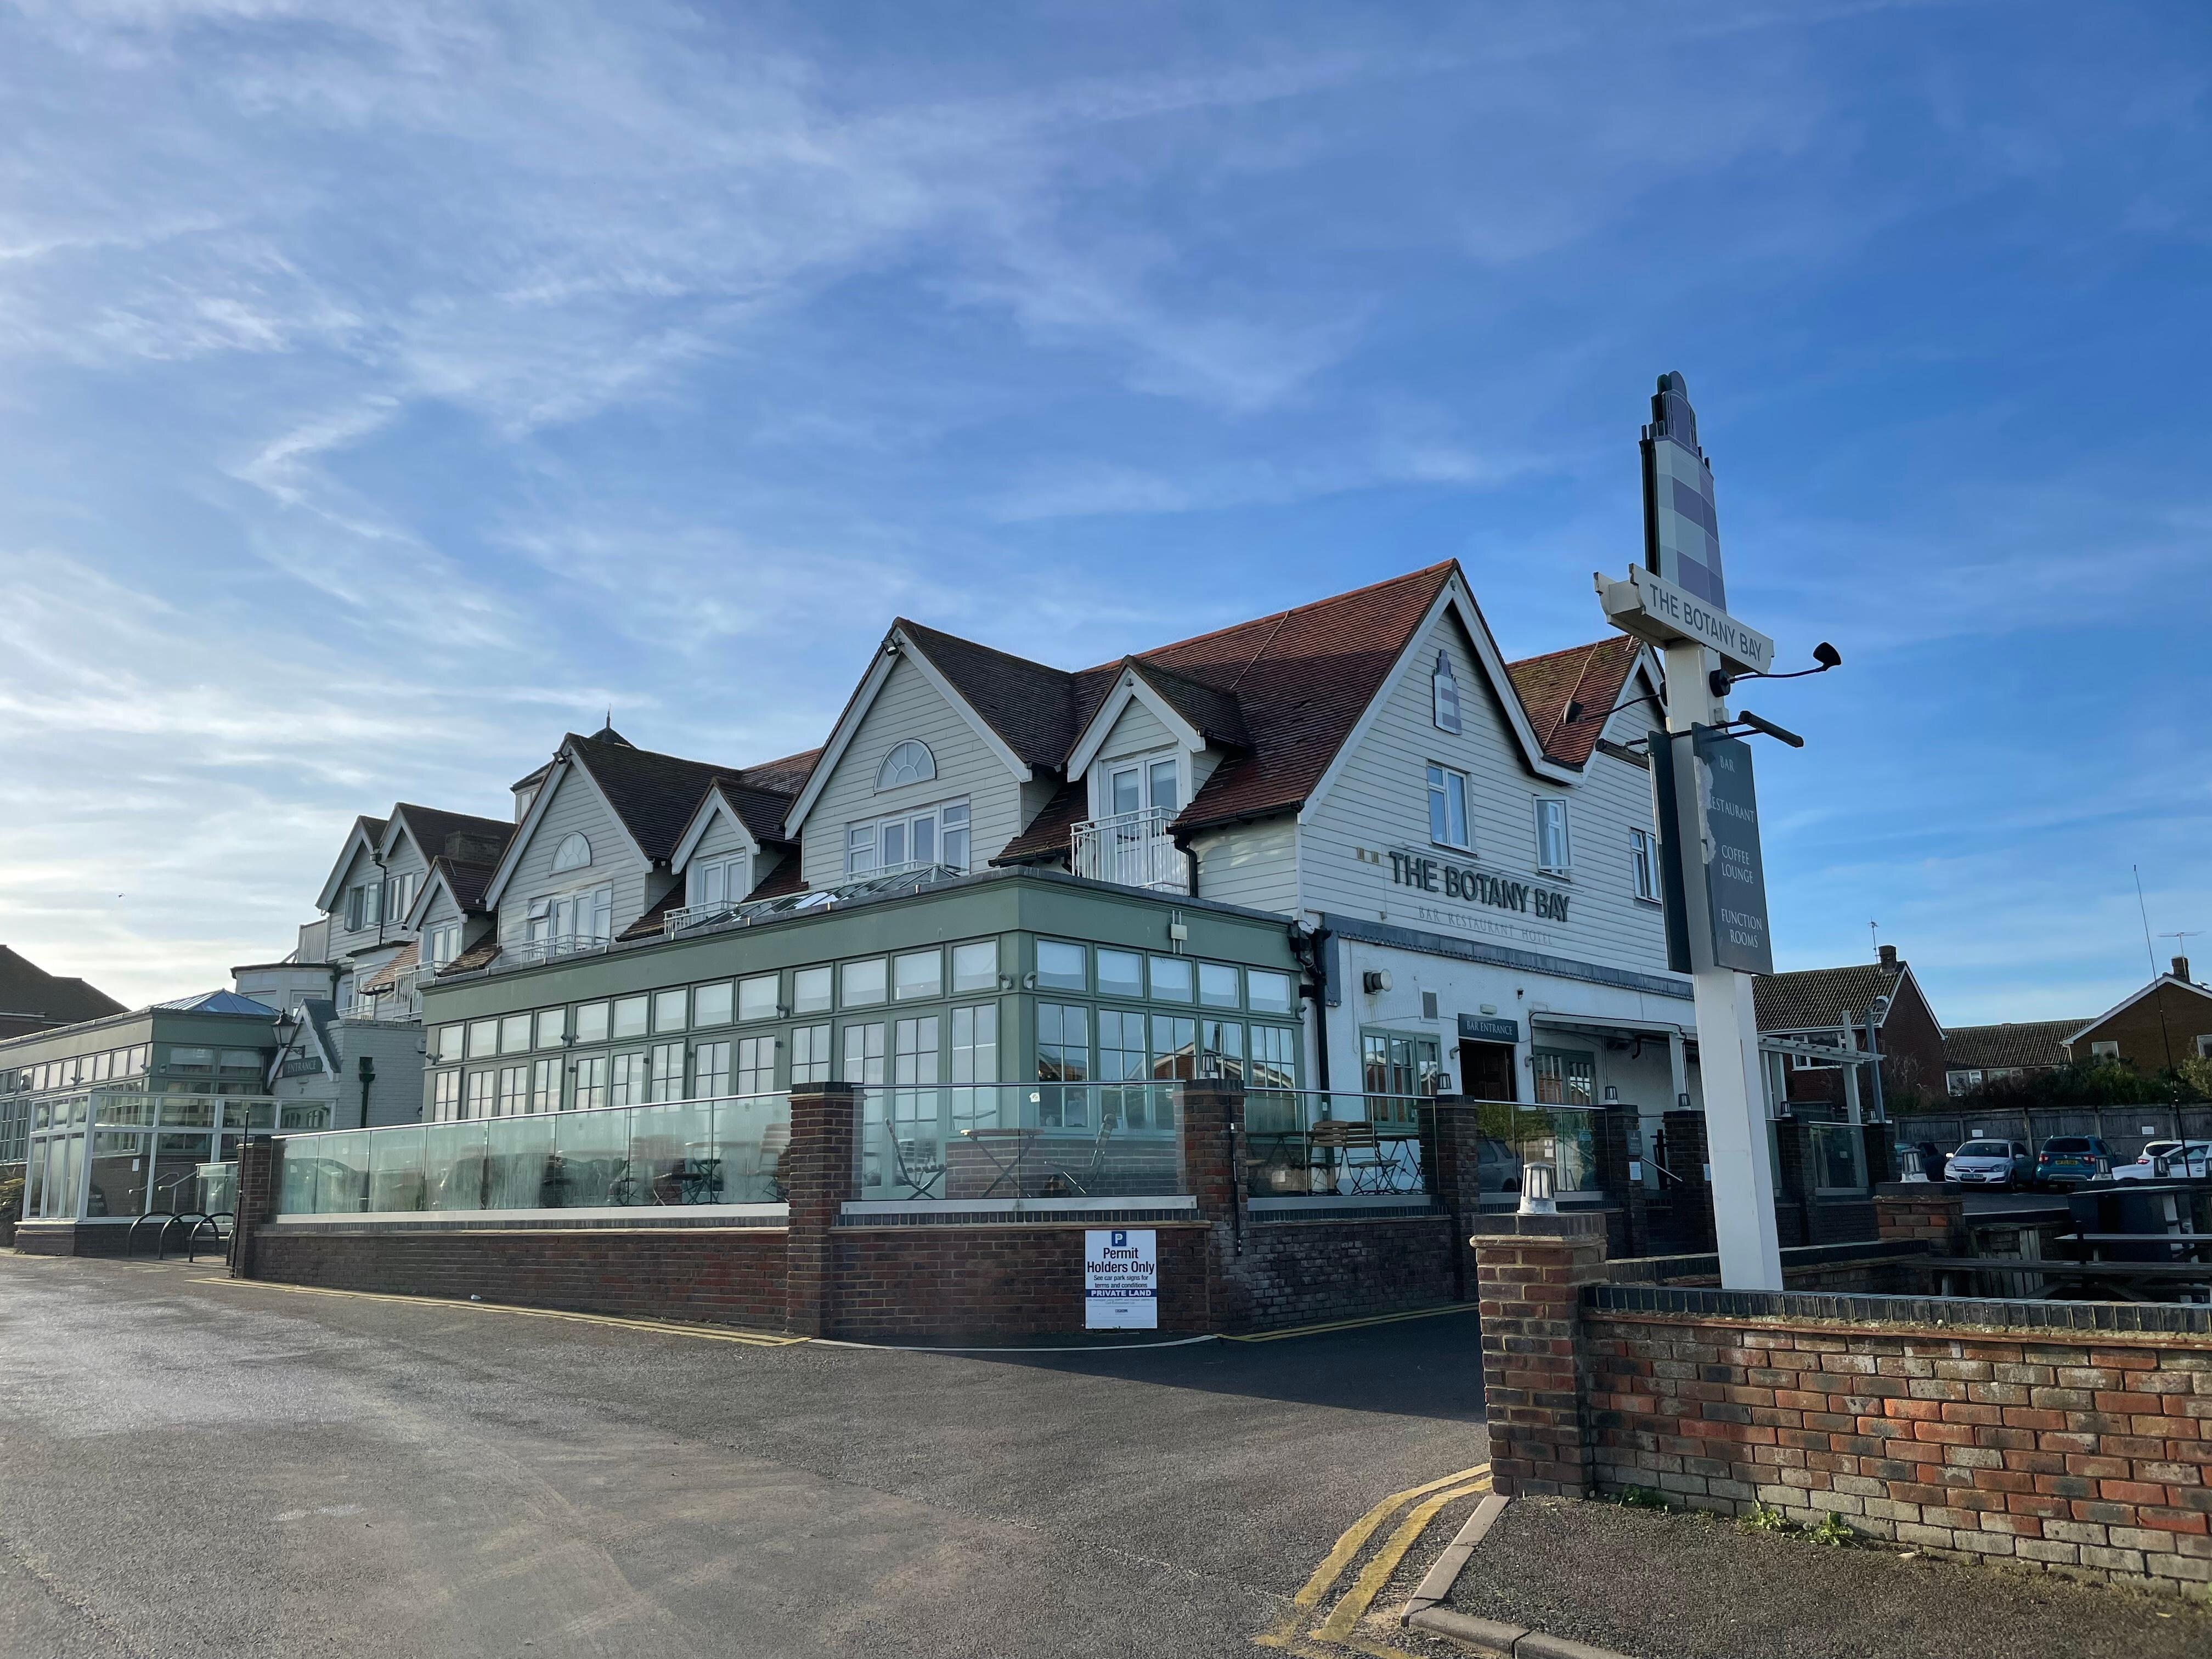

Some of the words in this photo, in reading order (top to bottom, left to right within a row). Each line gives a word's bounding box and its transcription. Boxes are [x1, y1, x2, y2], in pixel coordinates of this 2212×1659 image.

[1649, 583, 1679, 619] THE
[1684, 602, 1735, 648] BOTANY
[1740, 633, 1762, 662] BAY
[1719, 755, 1735, 773] BAR
[1711, 795, 1754, 823] ESTAURANT
[1722, 844, 1750, 866] COFFEE
[1722, 862, 1753, 884] LOUNGE
[1389, 850, 1439, 893] THE
[1446, 865, 1530, 913] BOTANY
[1535, 888, 1570, 922] BAY
[1419, 906, 1440, 923] BAR
[1448, 912, 1514, 937] RESTAURANT
[1522, 929, 1553, 945] HOTEL
[1721, 908, 1763, 932] FUNCTION
[1730, 929, 1759, 949] ROOMS
[1466, 1020, 1479, 1031] BAR
[1480, 1022, 1513, 1035] ENTRANCE
[287, 1059, 317, 1073] ENTRANCE
[1115, 1233, 1123, 1244] P
[1103, 1247, 1138, 1259] Permit
[1087, 1261, 1128, 1273] Holders
[1131, 1261, 1155, 1275] Only
